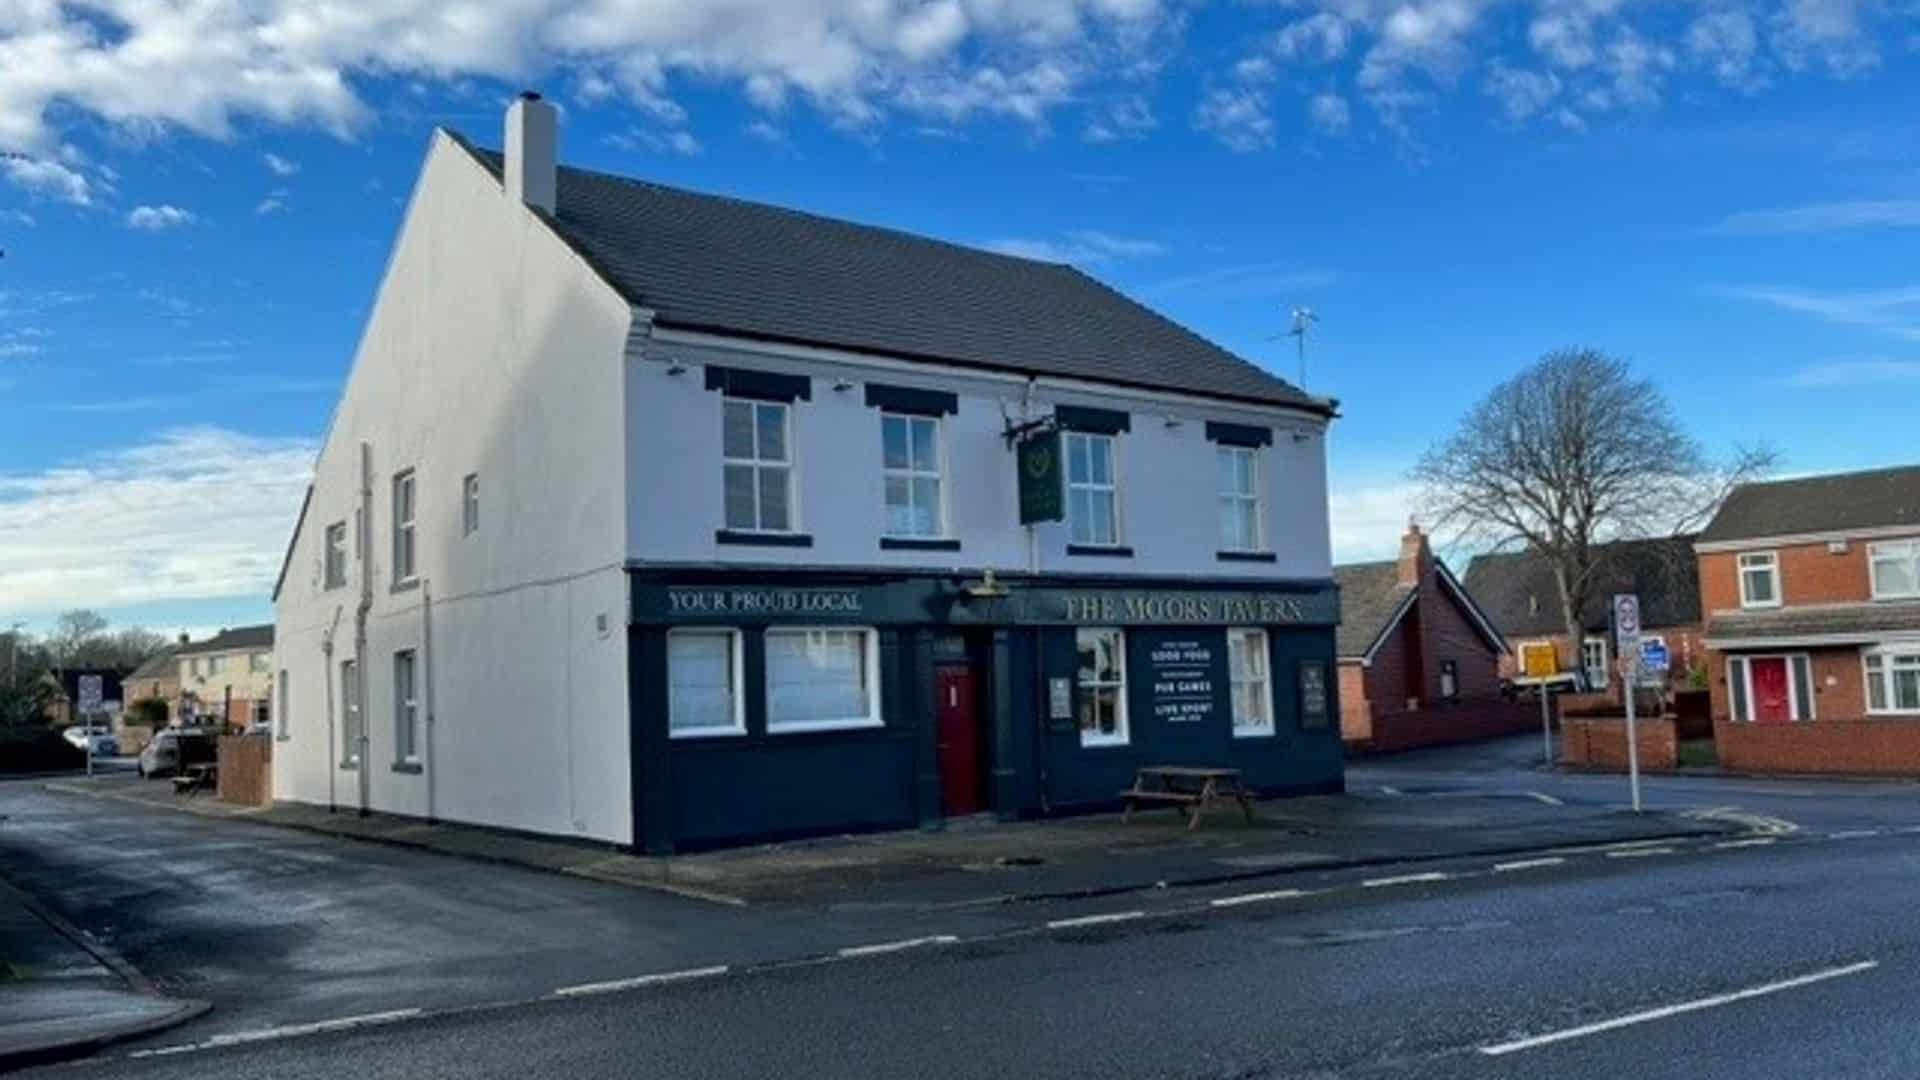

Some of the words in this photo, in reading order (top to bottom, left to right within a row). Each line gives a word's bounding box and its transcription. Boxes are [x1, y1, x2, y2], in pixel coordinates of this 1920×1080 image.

[668, 591, 728, 610] YOUR
[732, 591, 797, 610] PROUD
[802, 592, 862, 611] LOCAL
[1064, 597, 1115, 620] THE
[1125, 597, 1210, 620] MOORS
[1221, 598, 1303, 621] TAVERN
[1151, 650, 1180, 661] GOOD
[1154, 682, 1175, 693] PUB
[1177, 681, 1212, 692] GAMES
[1155, 705, 1178, 715] LIVE
